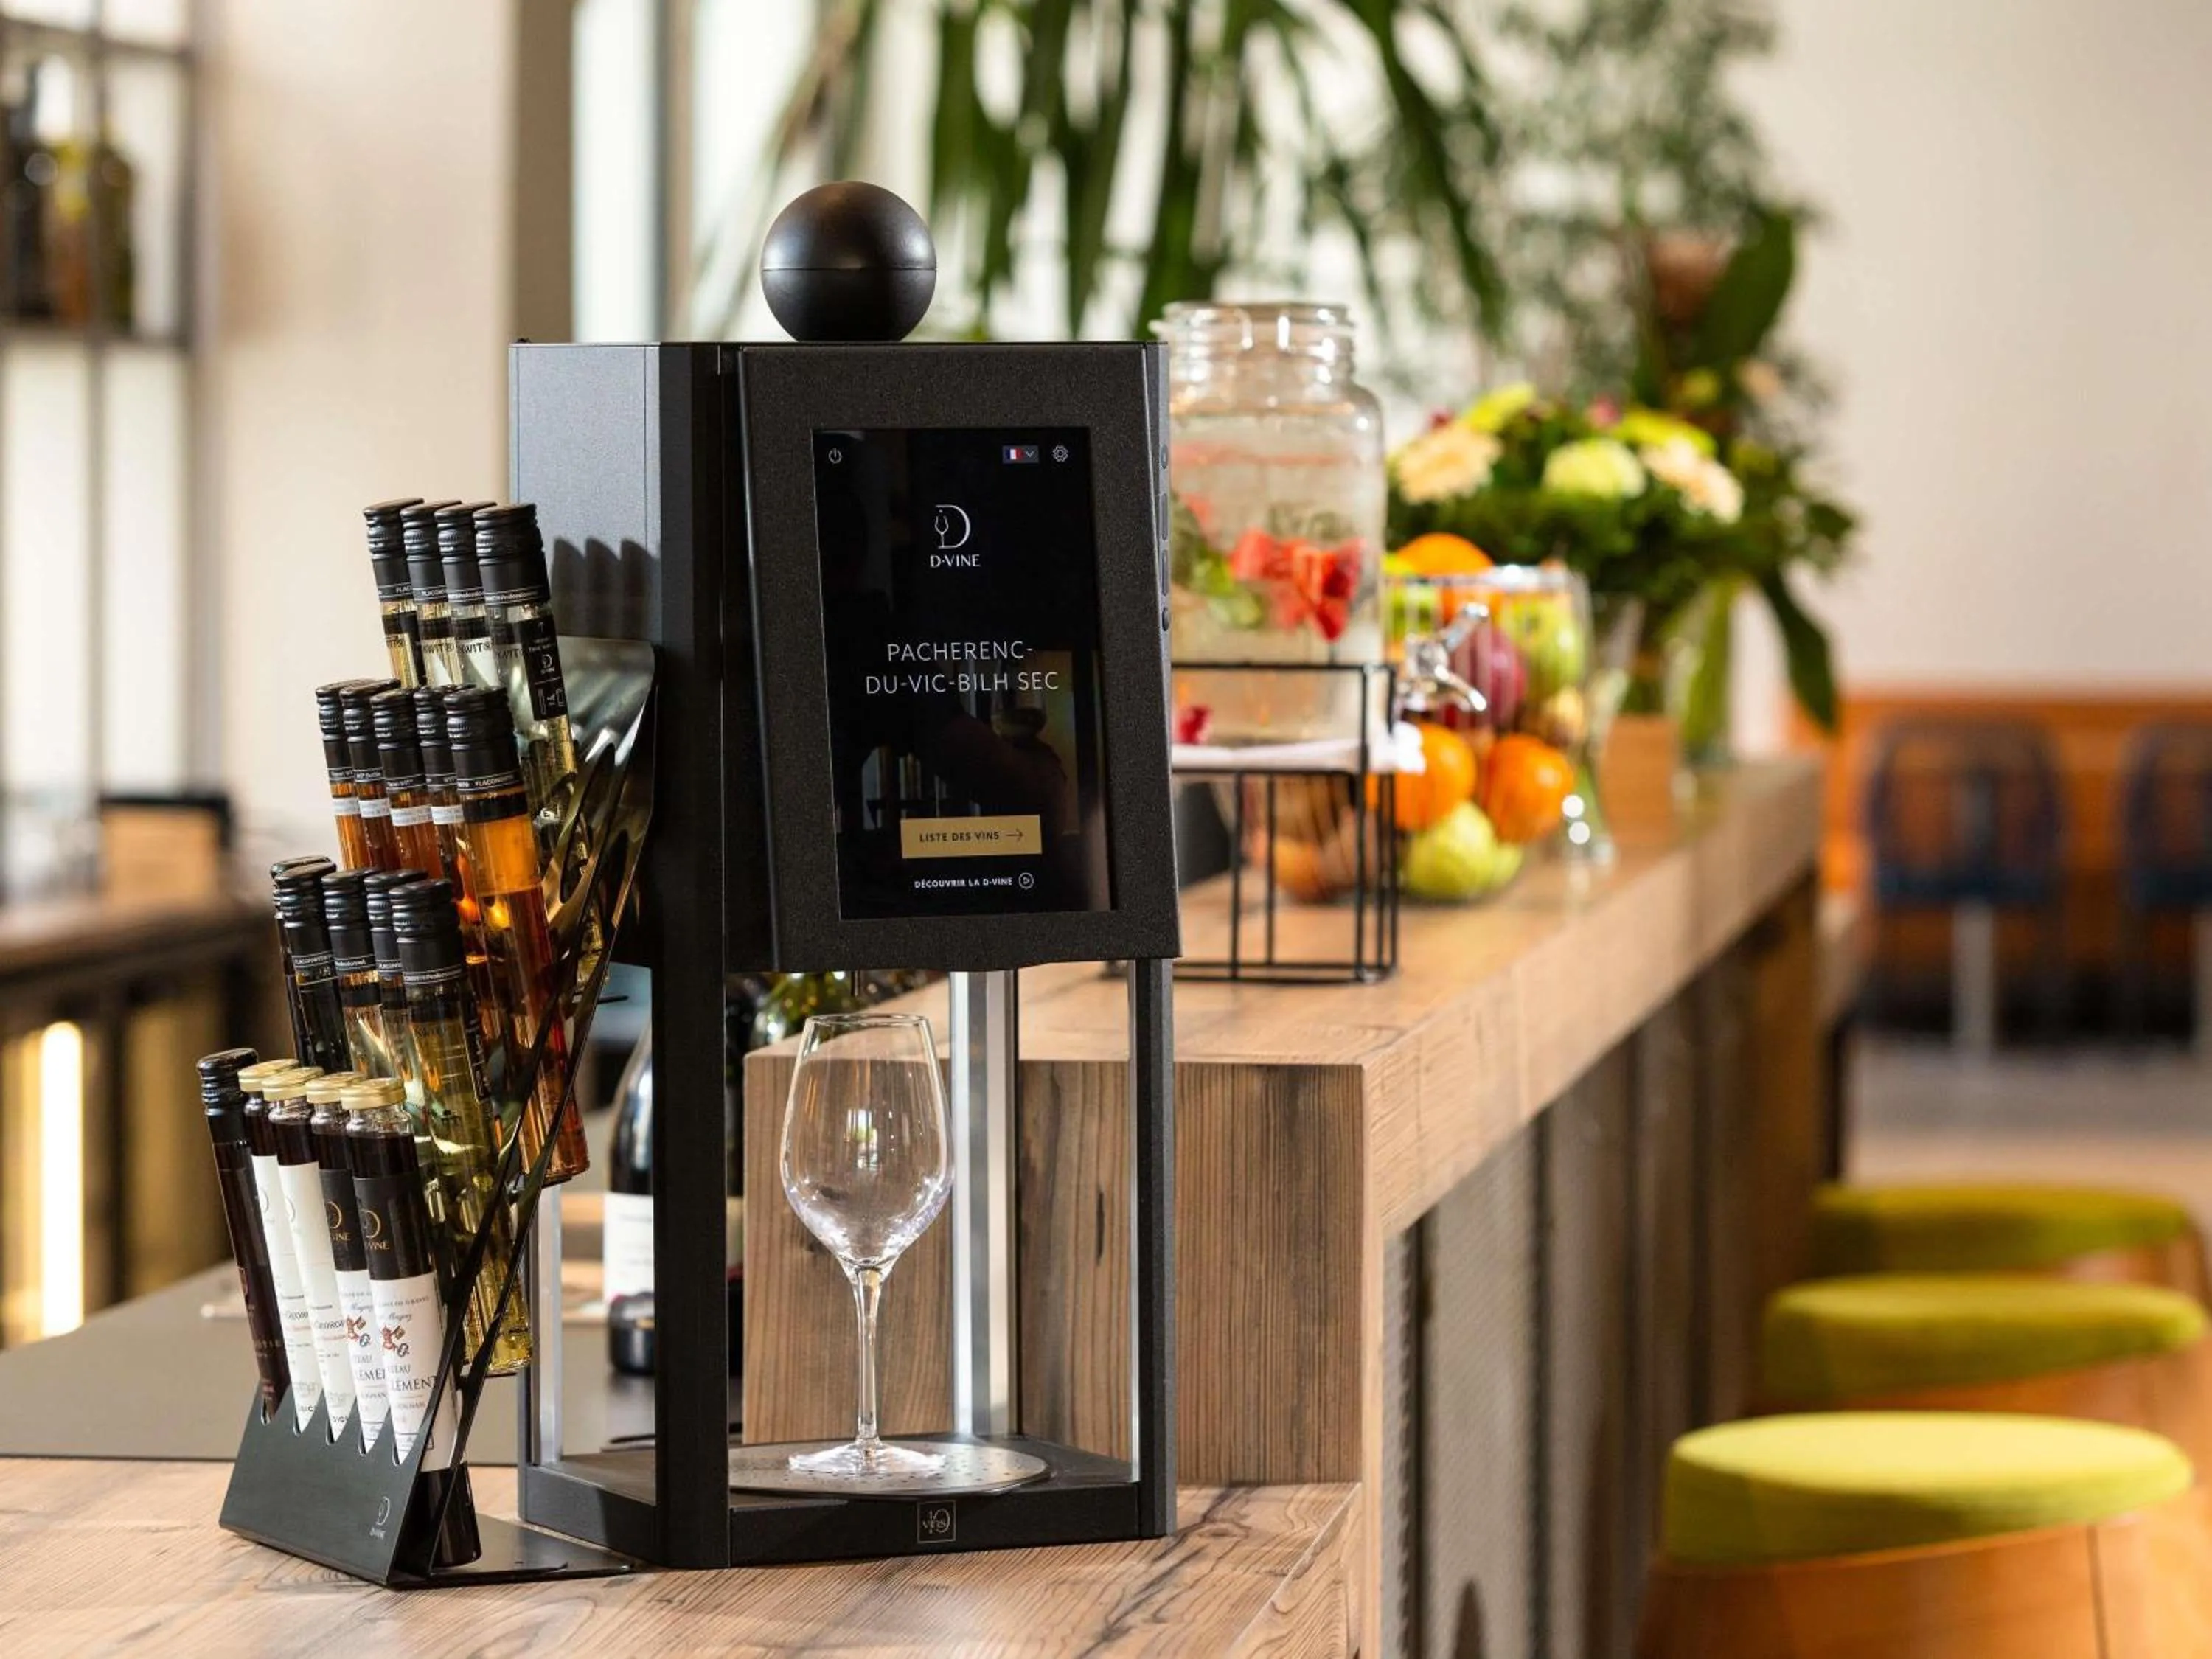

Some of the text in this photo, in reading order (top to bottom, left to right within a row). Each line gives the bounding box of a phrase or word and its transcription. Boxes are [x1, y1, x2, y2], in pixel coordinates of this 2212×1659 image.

[887, 640, 1033, 661] PACHERENC-
[866, 672, 1059, 694] DU-VIC-BILH SEC
[919, 831, 999, 843] LISTE DES VINS
[914, 877, 1012, 888] DÉCOUVRIR LA D-VINE
